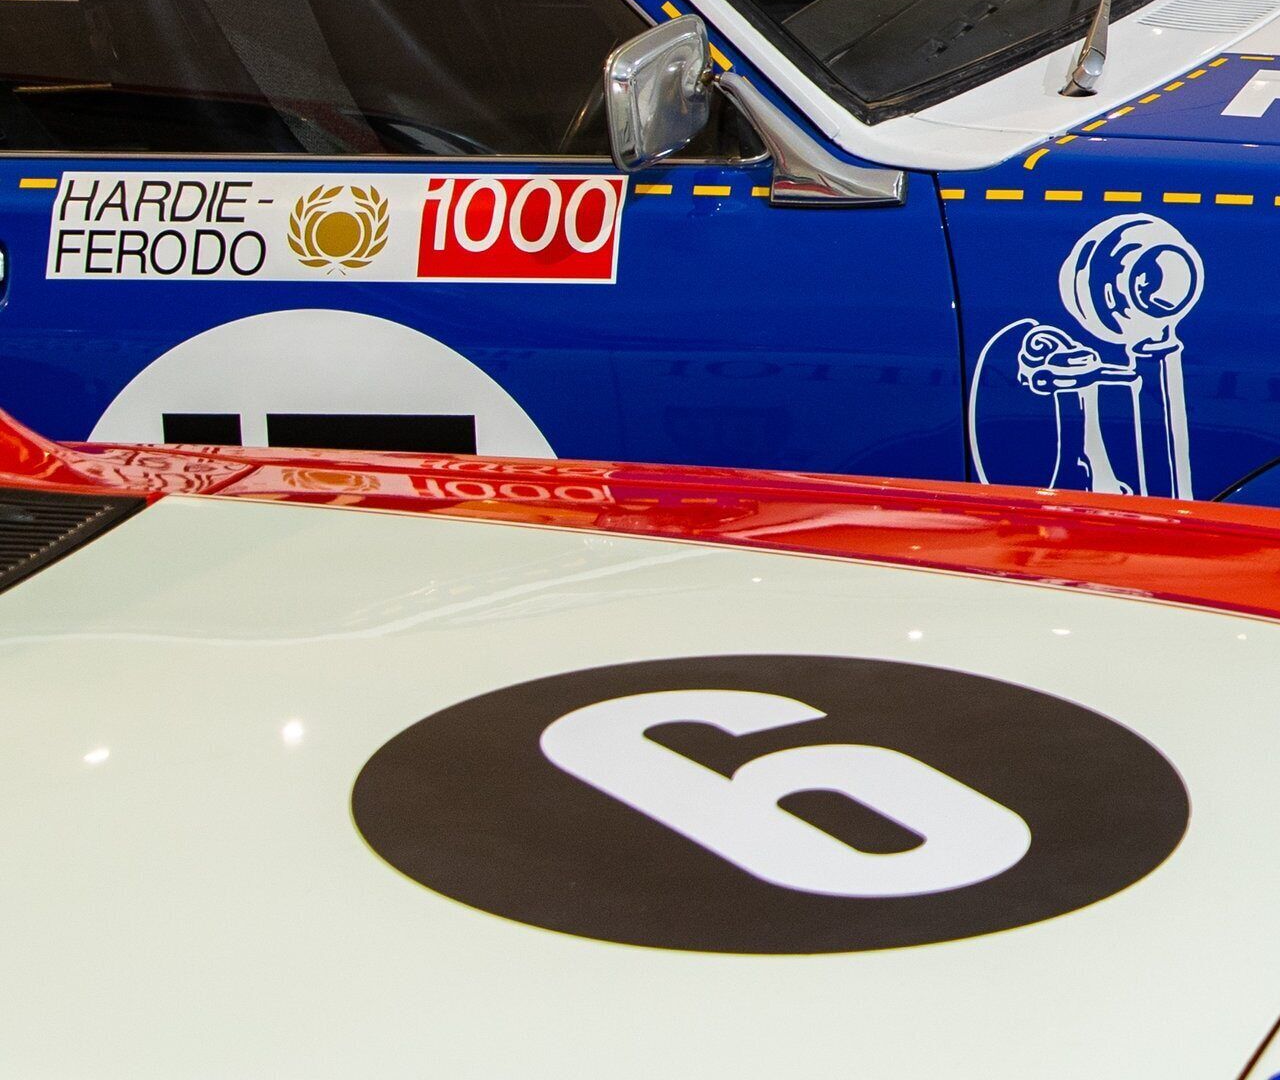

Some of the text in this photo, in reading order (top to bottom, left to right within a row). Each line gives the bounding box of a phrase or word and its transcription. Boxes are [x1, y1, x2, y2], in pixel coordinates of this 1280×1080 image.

[54, 230, 267, 276] FERODO
[425, 177, 614, 254] 1000
[540, 689, 1031, 896] 6
